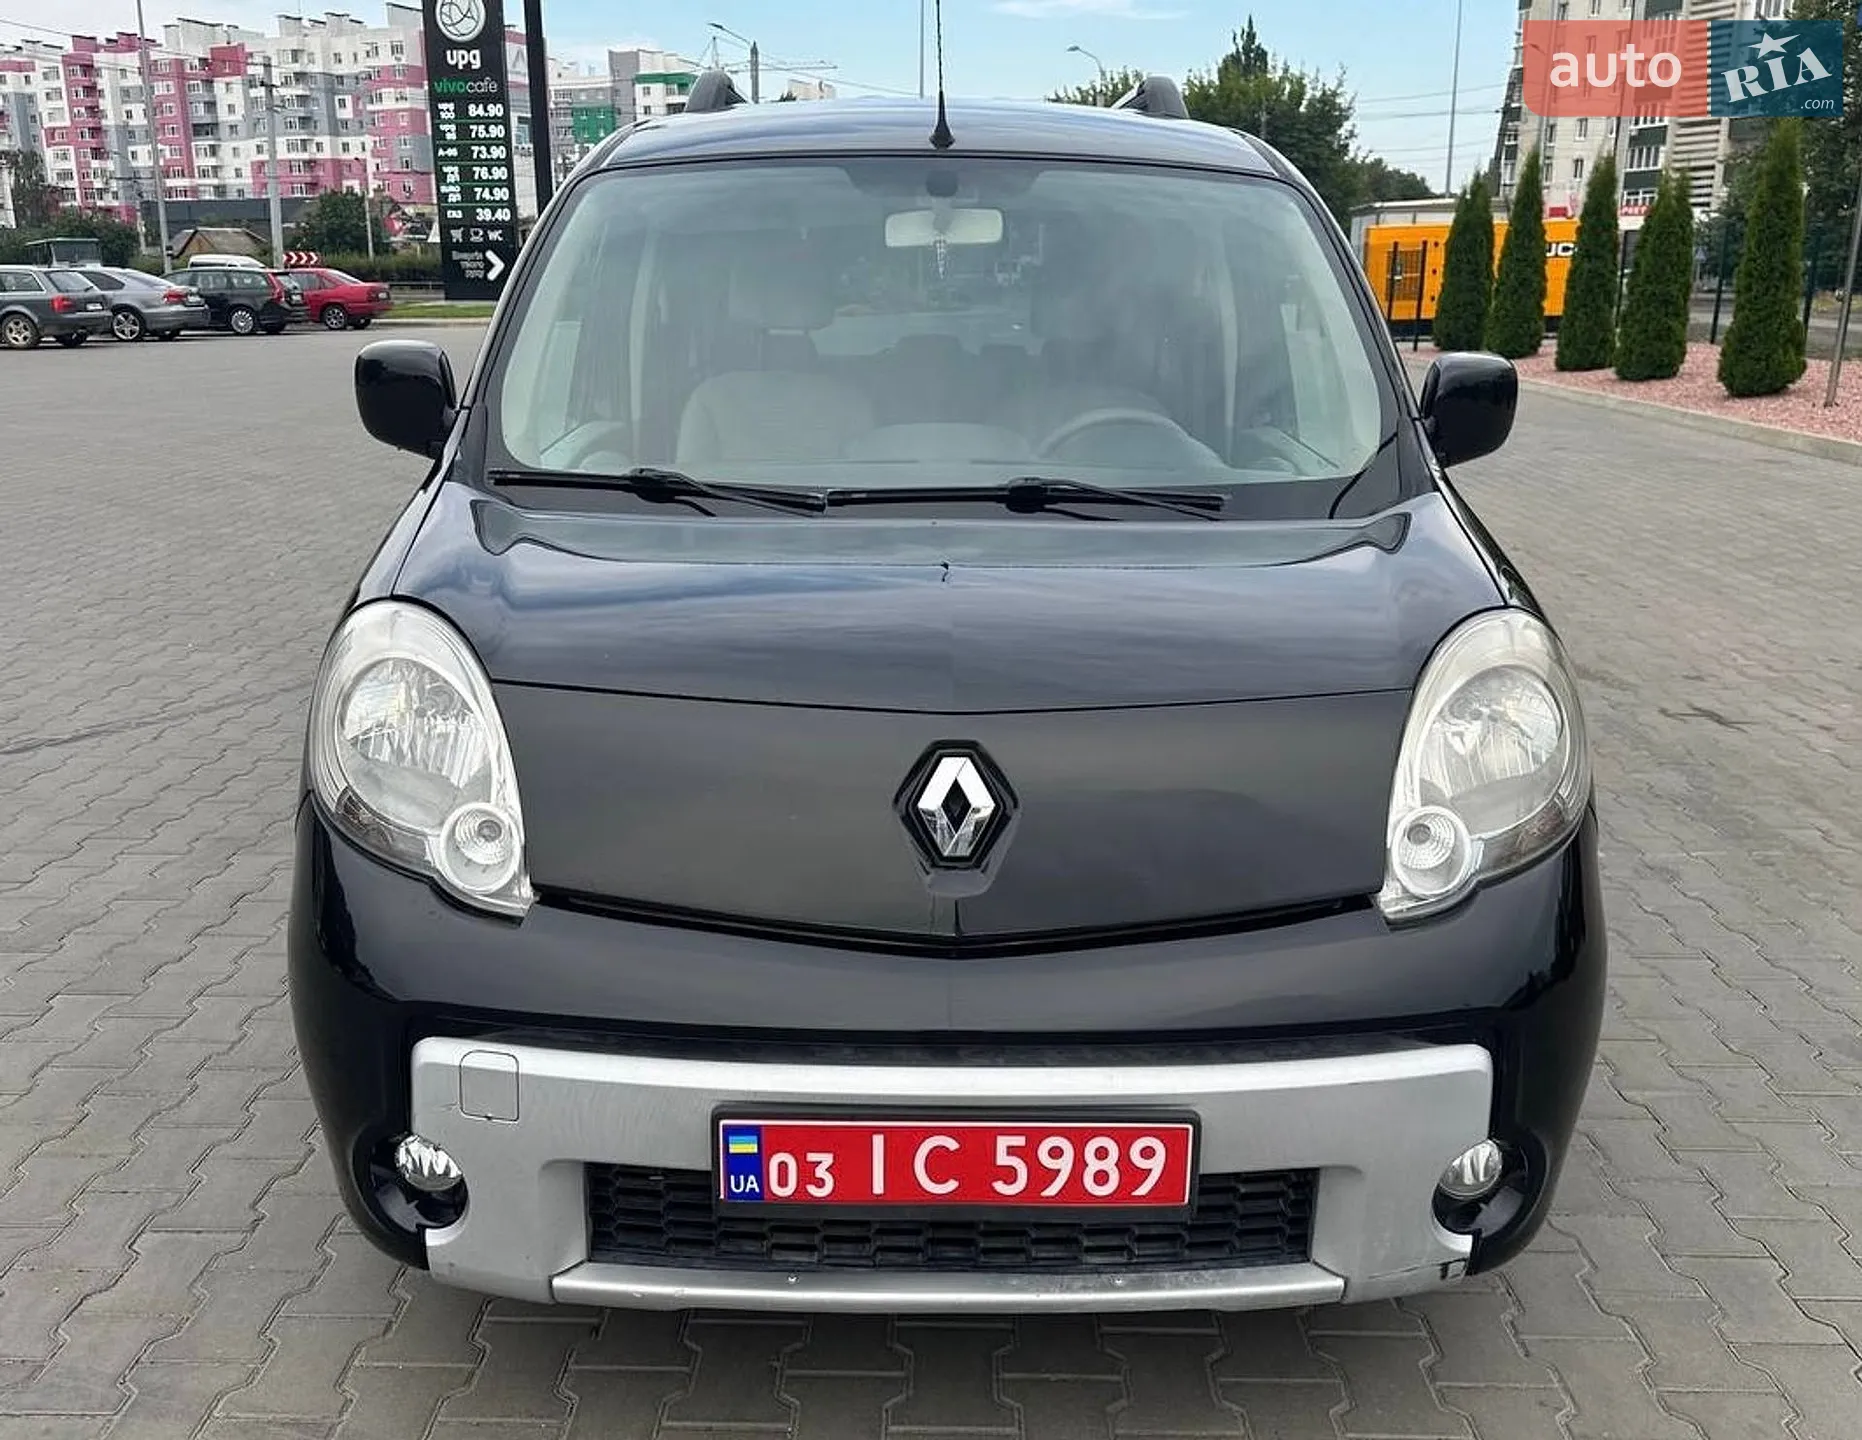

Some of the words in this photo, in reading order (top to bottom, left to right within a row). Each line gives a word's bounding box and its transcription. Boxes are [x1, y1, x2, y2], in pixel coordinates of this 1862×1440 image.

[446, 48, 482, 70] upg
[467, 103, 505, 118] 84.90
[469, 124, 506, 139] 75.90
[470, 145, 507, 160] 73.90
[472, 166, 509, 181] 76.90
[473, 187, 510, 201] 74.90
[476, 207, 512, 222] 39.40
[768, 1151, 836, 1198] 03
[990, 1135, 1168, 1197] 5989
[730, 1173, 760, 1194] UA
